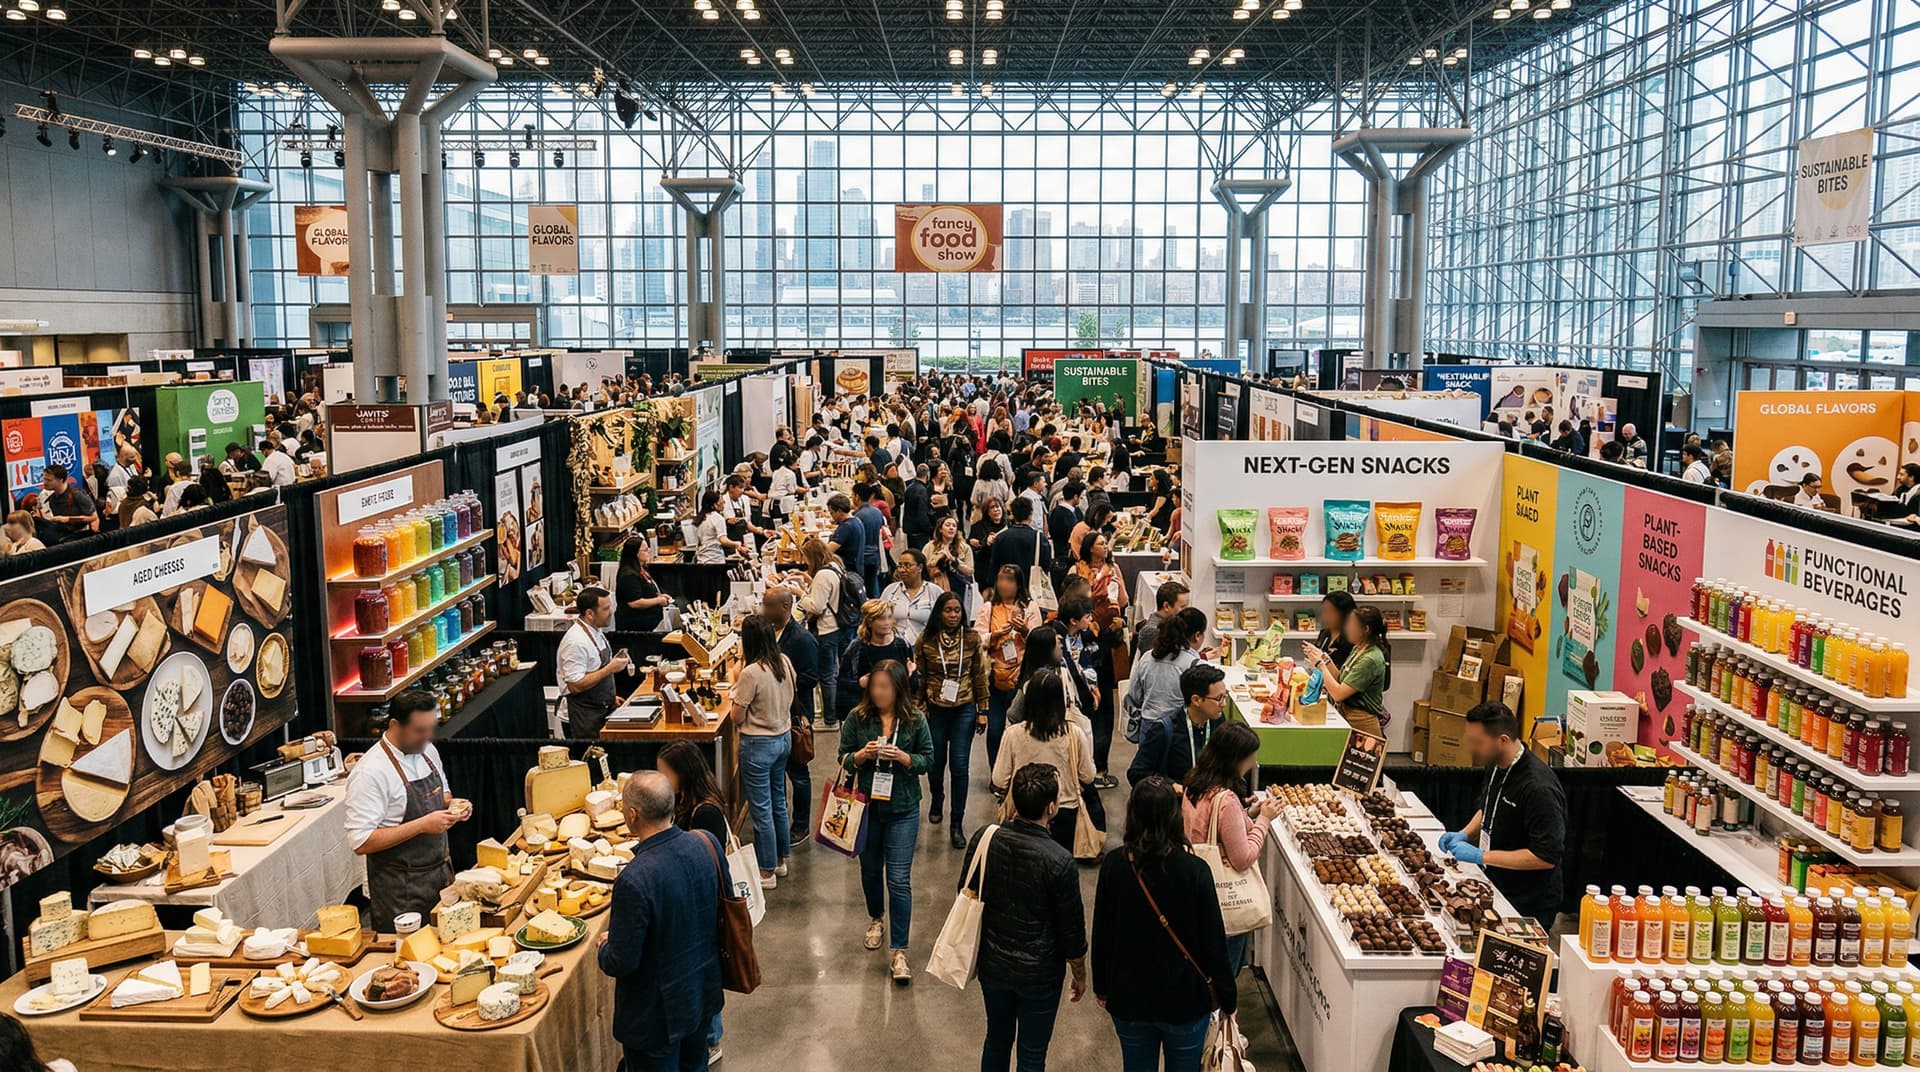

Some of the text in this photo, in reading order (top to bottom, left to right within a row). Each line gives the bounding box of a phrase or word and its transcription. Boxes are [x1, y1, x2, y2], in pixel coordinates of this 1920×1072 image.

[1801, 153, 1868, 179] SUSTAINABLE
[1817, 175, 1848, 194] BITES
[313, 228, 348, 237] GLOBAL
[533, 224, 571, 235] GLOBAL
[931, 217, 973, 232] fancy
[311, 237, 349, 246] FLAVOR
[532, 235, 574, 246] FLAVORS
[920, 227, 976, 248] food
[938, 248, 976, 261] show
[1063, 366, 1128, 376] SUSTAINABLE
[1082, 377, 1109, 386] BITES
[1760, 402, 1877, 415] GLOBAL FLAVORS
[1244, 456, 1450, 475] NEXT-GEN SNACKS
[1516, 485, 1539, 505] PLANT
[1644, 512, 1681, 538] PLANT-
[1643, 533, 1678, 559] BASED
[132, 558, 185, 586] AGED CHEESES
[1639, 552, 1681, 582] SNACKS
[1804, 548, 1908, 596] FUNCTIONAL
[1803, 571, 1902, 619] BEVERAGES
